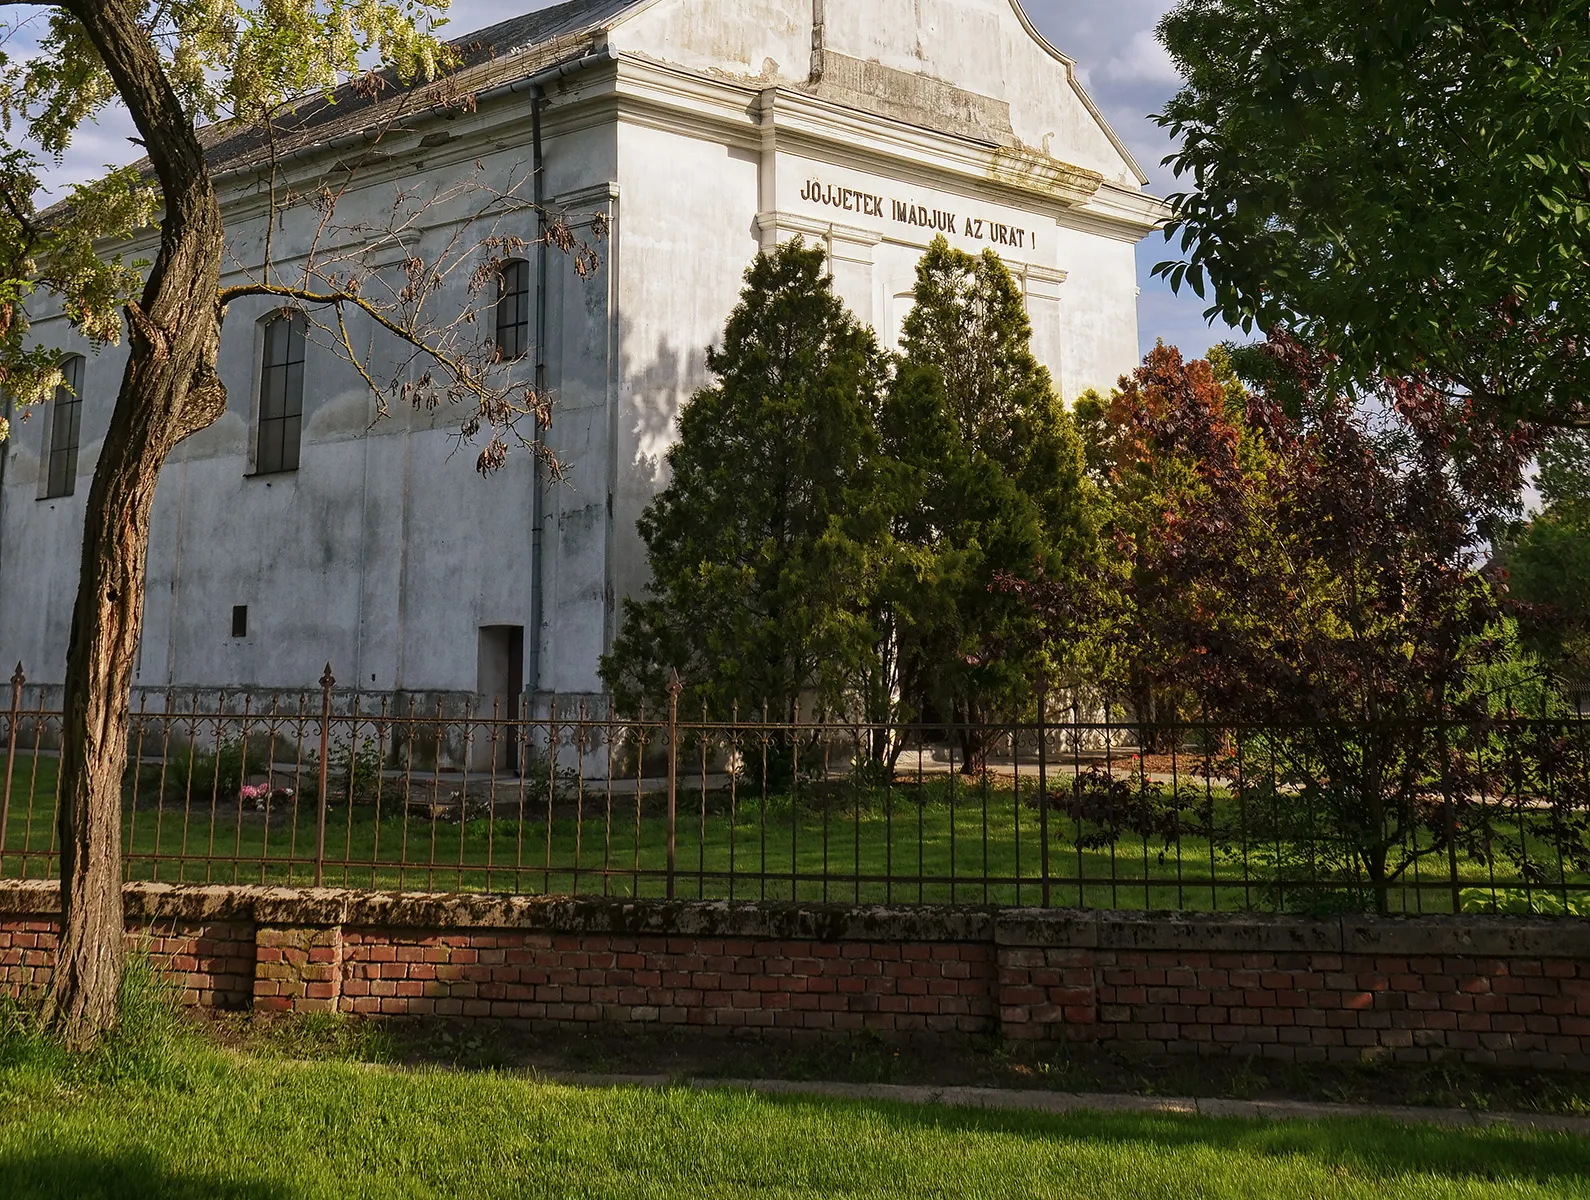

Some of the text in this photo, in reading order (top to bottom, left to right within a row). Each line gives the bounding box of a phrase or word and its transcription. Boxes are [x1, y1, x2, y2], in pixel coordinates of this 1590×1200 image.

[800, 177, 884, 218] JÖJJETEK
[964, 217, 984, 240] AZ
[989, 222, 1025, 248] URAT
